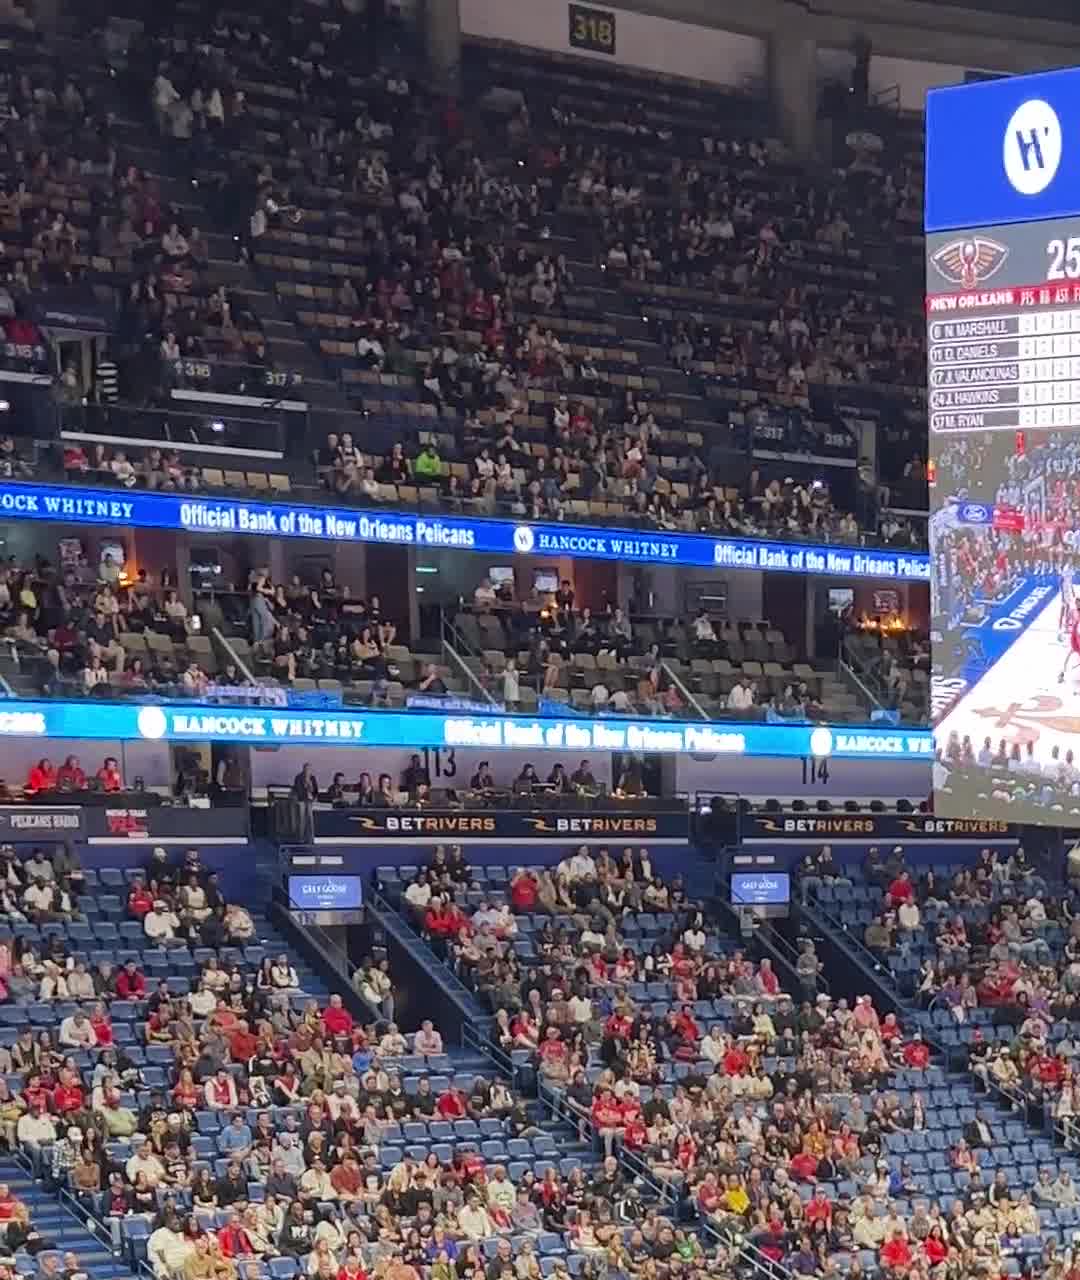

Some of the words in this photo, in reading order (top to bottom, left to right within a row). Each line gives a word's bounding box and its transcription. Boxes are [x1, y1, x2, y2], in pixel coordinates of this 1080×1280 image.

[0, 493, 38, 512] OCK
[44, 496, 133, 519] WHITNEY
[180, 503, 235, 529] Official
[239, 508, 277, 531] Bank
[280, 511, 298, 533] of
[299, 513, 323, 535] the
[326, 515, 356, 537] New
[359, 518, 413, 541] Orleans
[416, 521, 475, 546] Pelicans
[539, 534, 606, 553] HANCOCK
[610, 538, 679, 559] WHITNEY
[714, 543, 757, 565] Official
[759, 547, 790, 567] Bank
[792, 551, 803, 568] of
[806, 552, 825, 570] the
[827, 554, 852, 572] New
[853, 556, 895, 575] Orleans
[173, 715, 267, 735] HANCOCK
[272, 717, 365, 738] WHITNEY
[801, 758, 830, 785] 114
[386, 817, 496, 831] BETRIVERS
[556, 818, 657, 832] BETRIVERS
[784, 819, 874, 832] BETRIVERS
[925, 819, 1008, 833] BETRIVERS
